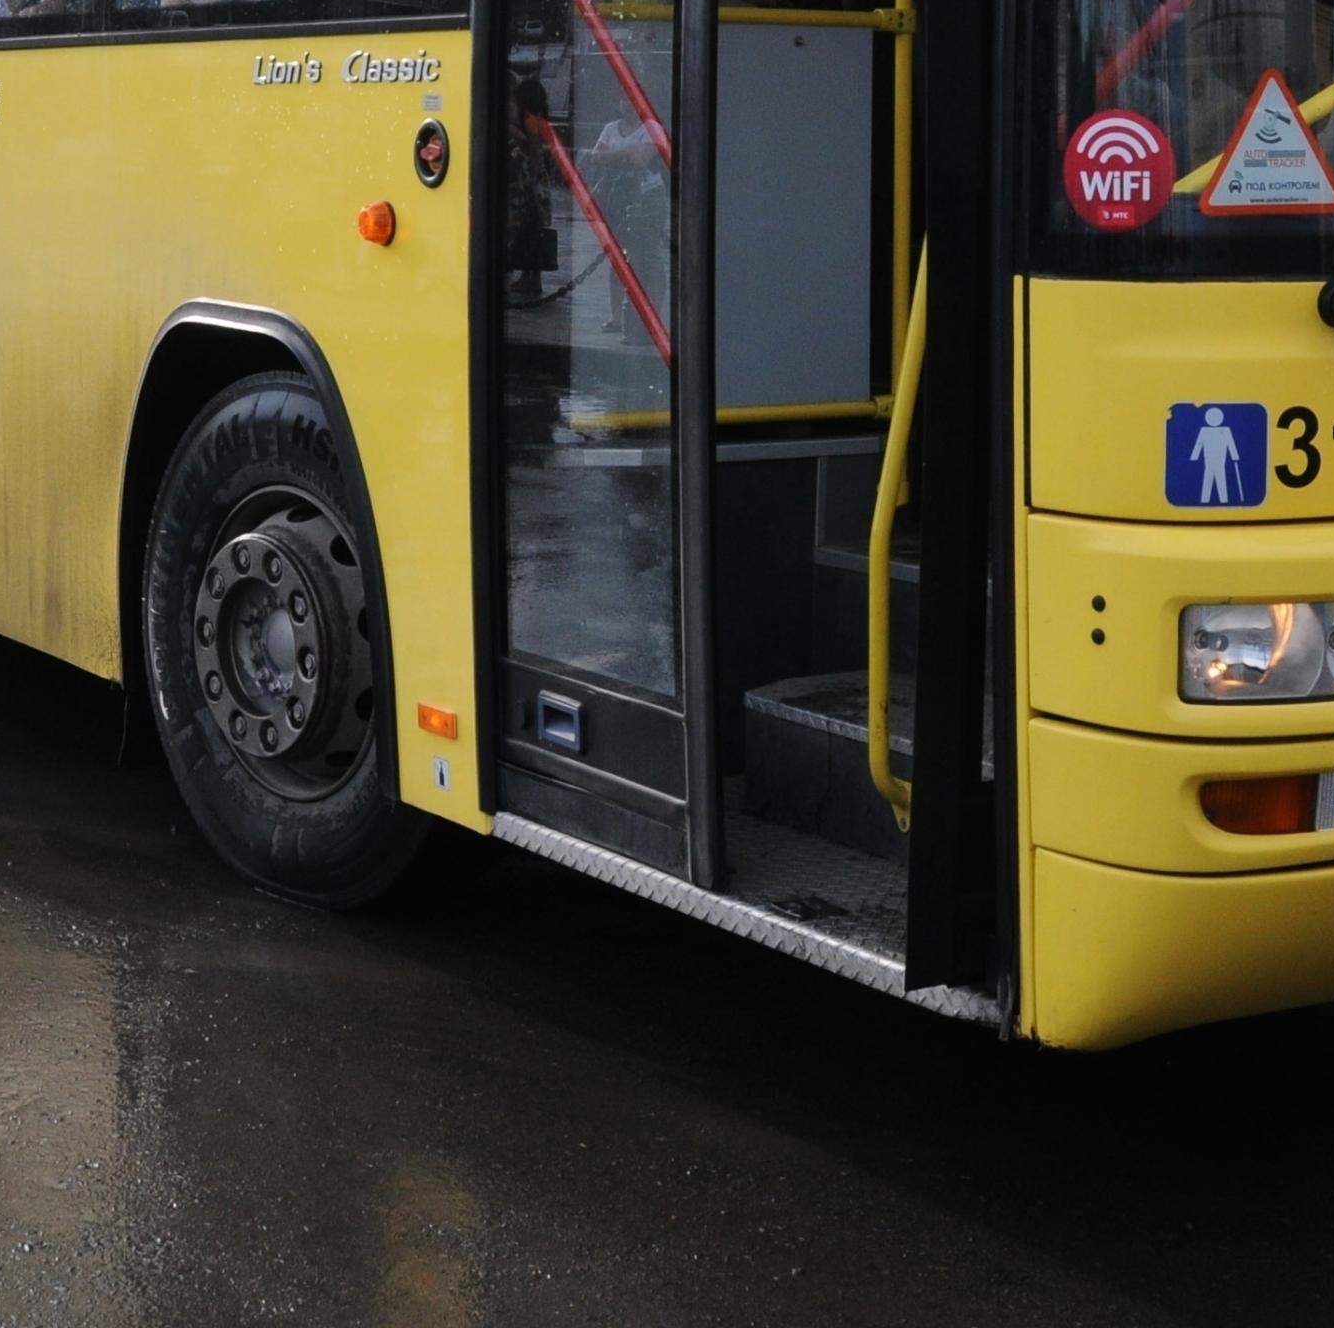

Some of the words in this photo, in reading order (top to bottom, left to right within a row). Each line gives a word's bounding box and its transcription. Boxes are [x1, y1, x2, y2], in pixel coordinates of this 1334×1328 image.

[252, 51, 322, 85] Lion's
[341, 48, 441, 84] Classic
[1244, 149, 1268, 159] AUTO
[1269, 159, 1306, 168] TRACKER
[1079, 170, 1152, 203] WiFi
[1246, 181, 1266, 192] ПОД
